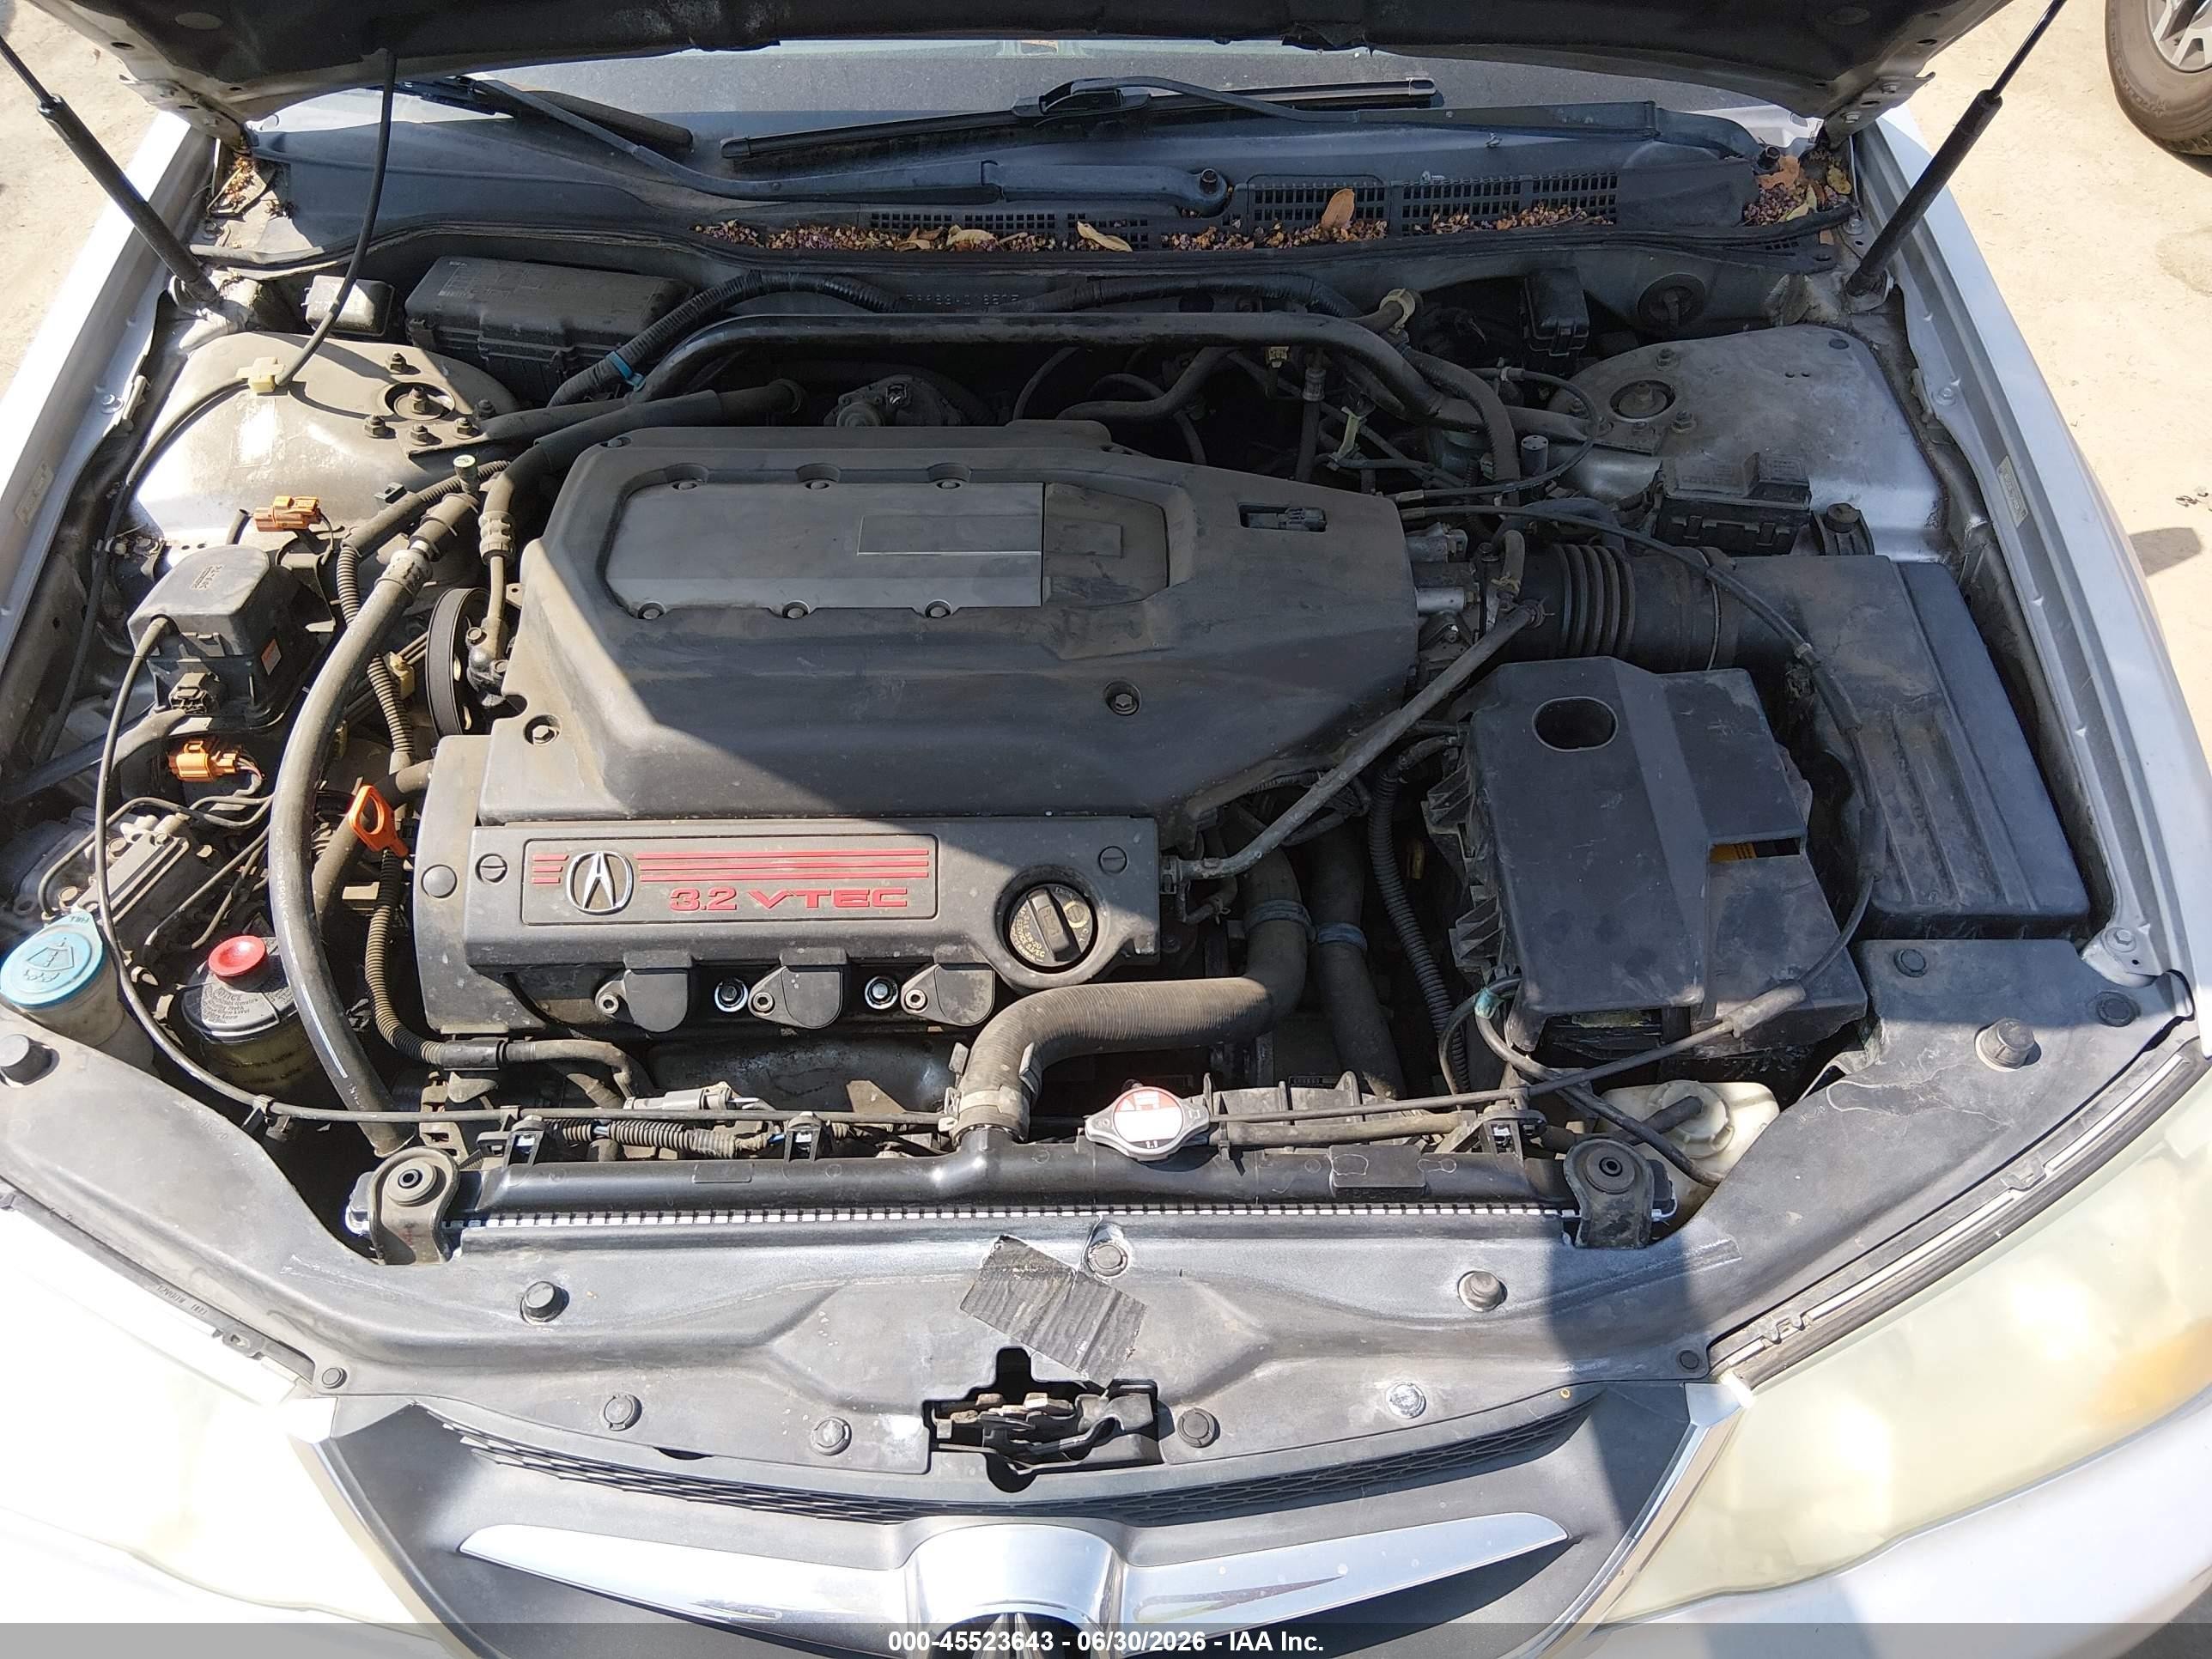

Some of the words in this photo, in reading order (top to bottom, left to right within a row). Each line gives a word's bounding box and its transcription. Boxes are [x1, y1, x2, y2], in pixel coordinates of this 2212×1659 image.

[670, 886, 737, 912] 3.2
[749, 886, 908, 910] VTEC
[1146, 1140, 1158, 1149] 1.1
